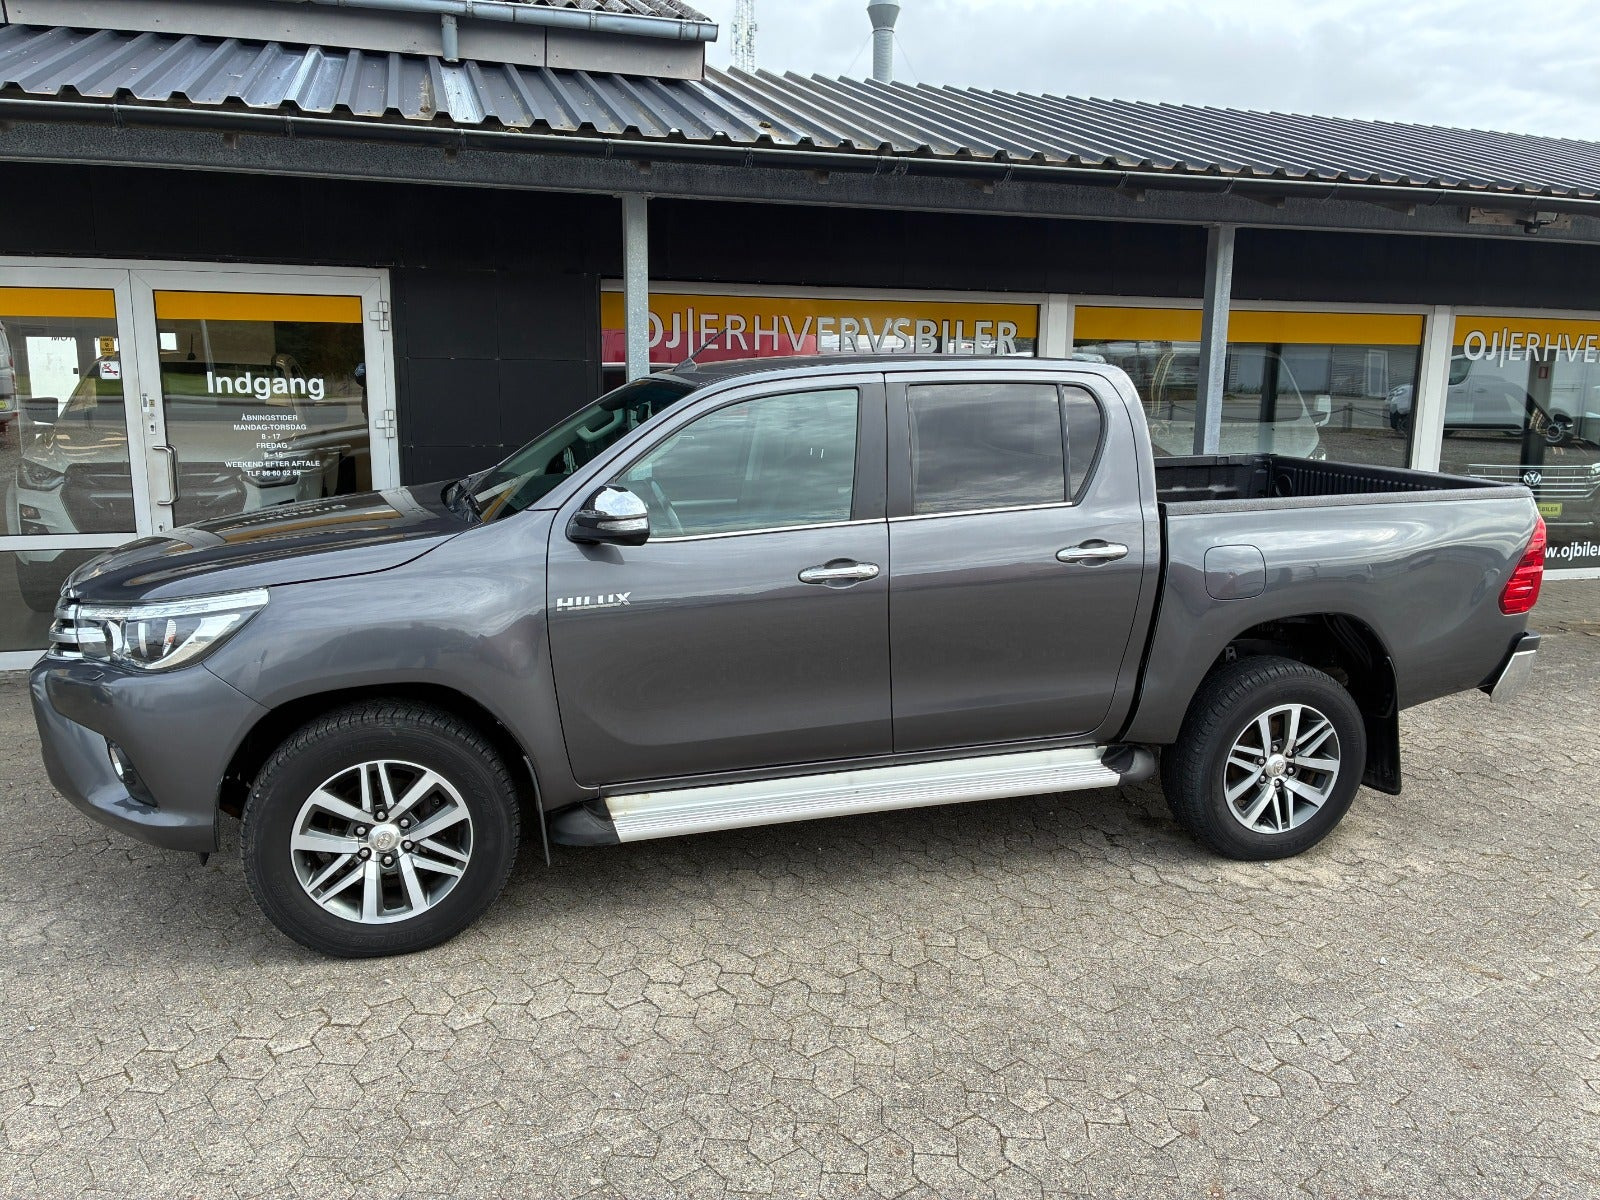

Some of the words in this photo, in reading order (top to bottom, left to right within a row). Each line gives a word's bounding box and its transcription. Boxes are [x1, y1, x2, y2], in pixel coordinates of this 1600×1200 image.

[206, 371, 325, 400] Indgang
[241, 413, 298, 421] ÅBNINGSTIDER
[556, 591, 632, 612] HILUX
